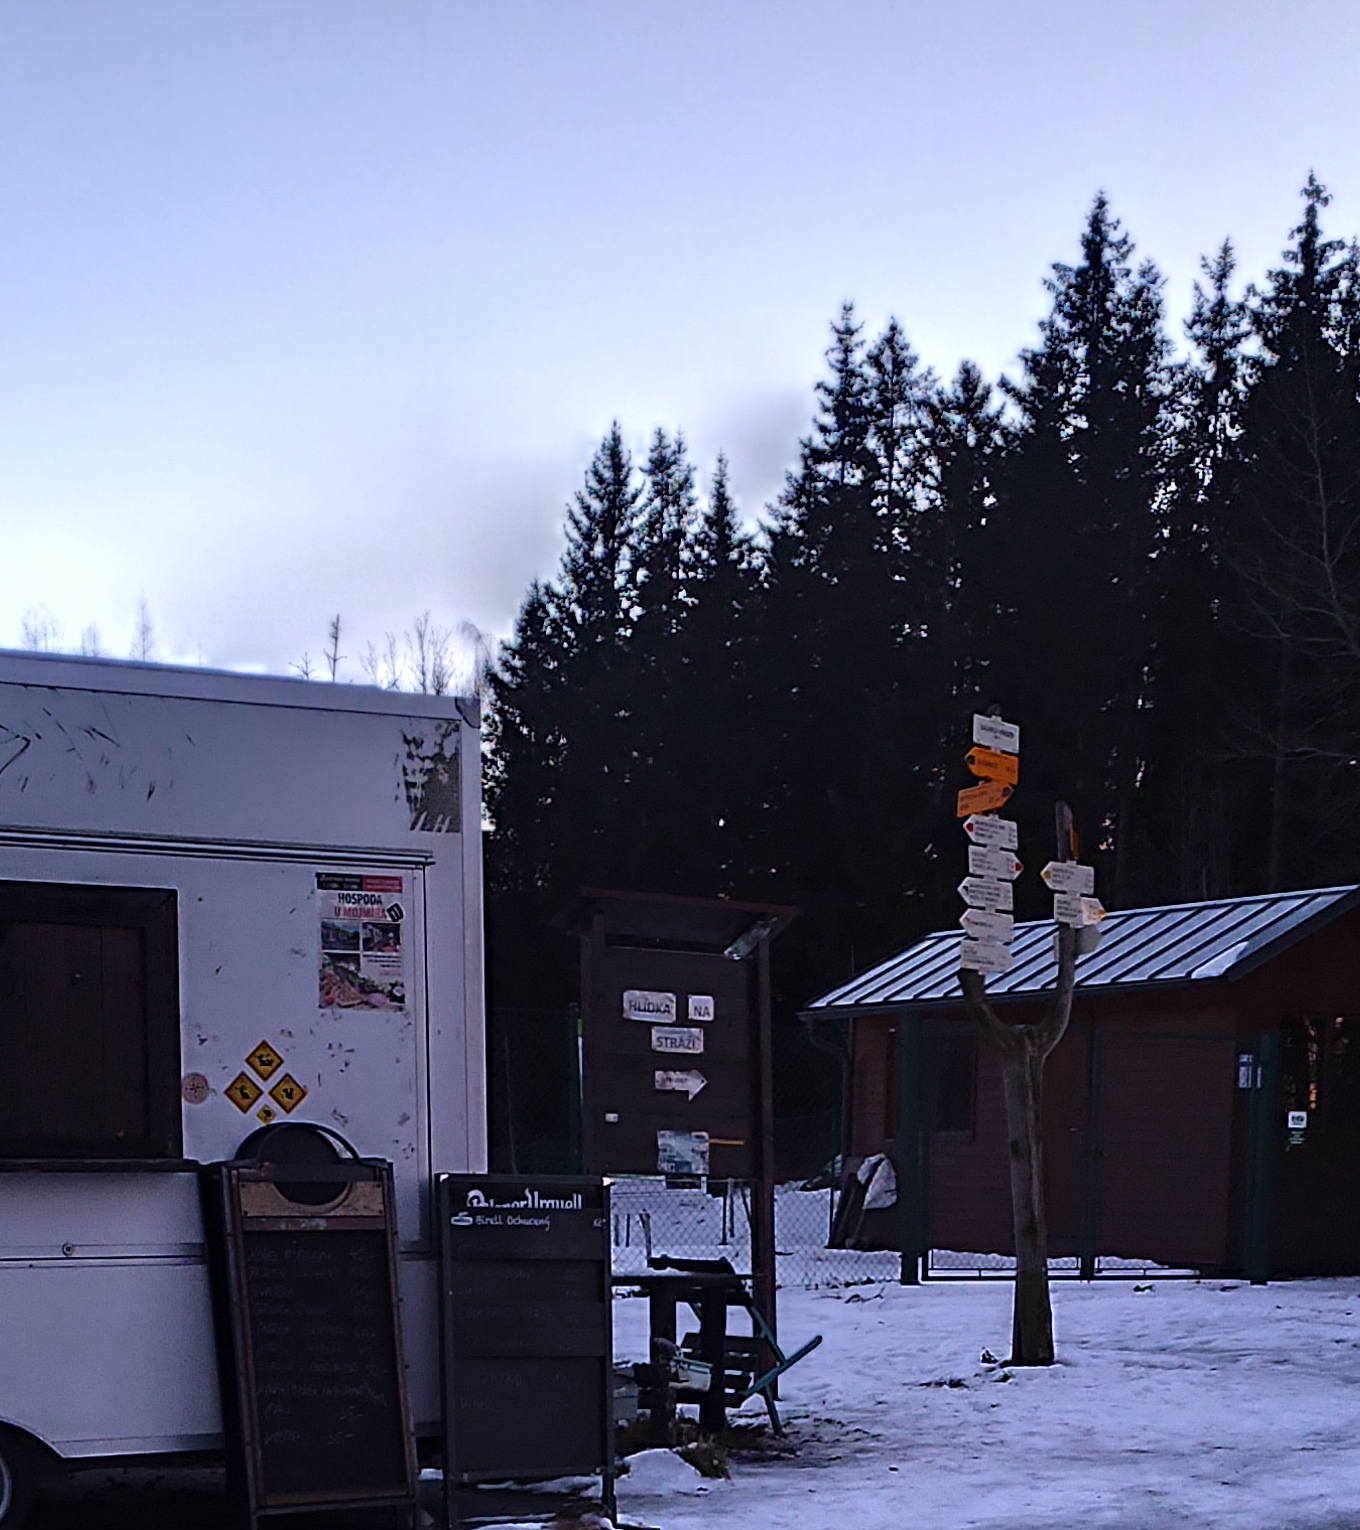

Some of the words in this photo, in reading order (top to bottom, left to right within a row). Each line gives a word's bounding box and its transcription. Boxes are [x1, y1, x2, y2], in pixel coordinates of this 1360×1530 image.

[337, 892, 383, 906] HOSPODA
[628, 997, 671, 1015] HLÍDKA
[693, 1004, 712, 1018] NA
